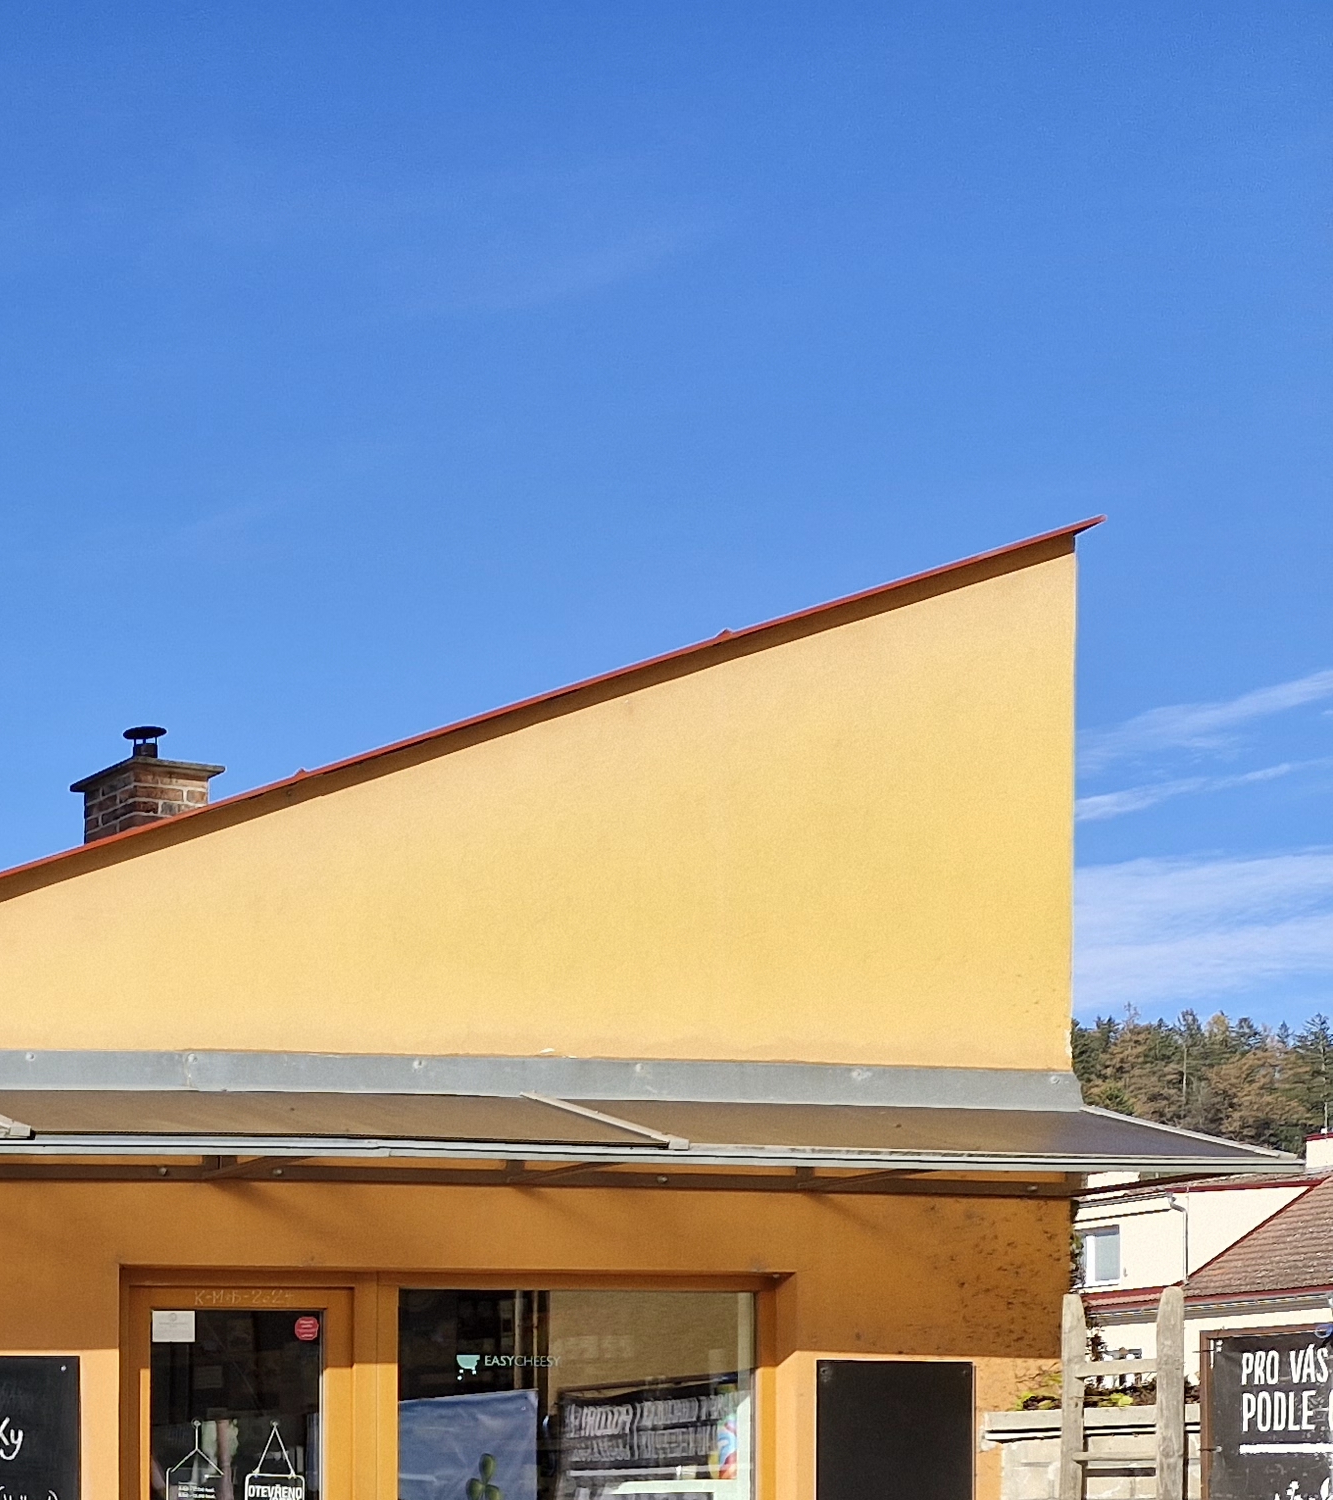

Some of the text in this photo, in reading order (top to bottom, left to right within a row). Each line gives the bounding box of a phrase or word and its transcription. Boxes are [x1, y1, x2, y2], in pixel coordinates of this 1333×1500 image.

[1241, 1343, 1329, 1386] PRO VÁS
[1242, 1390, 1317, 1432] PODLE
[248, 1483, 303, 1499] OTEVŘENO
